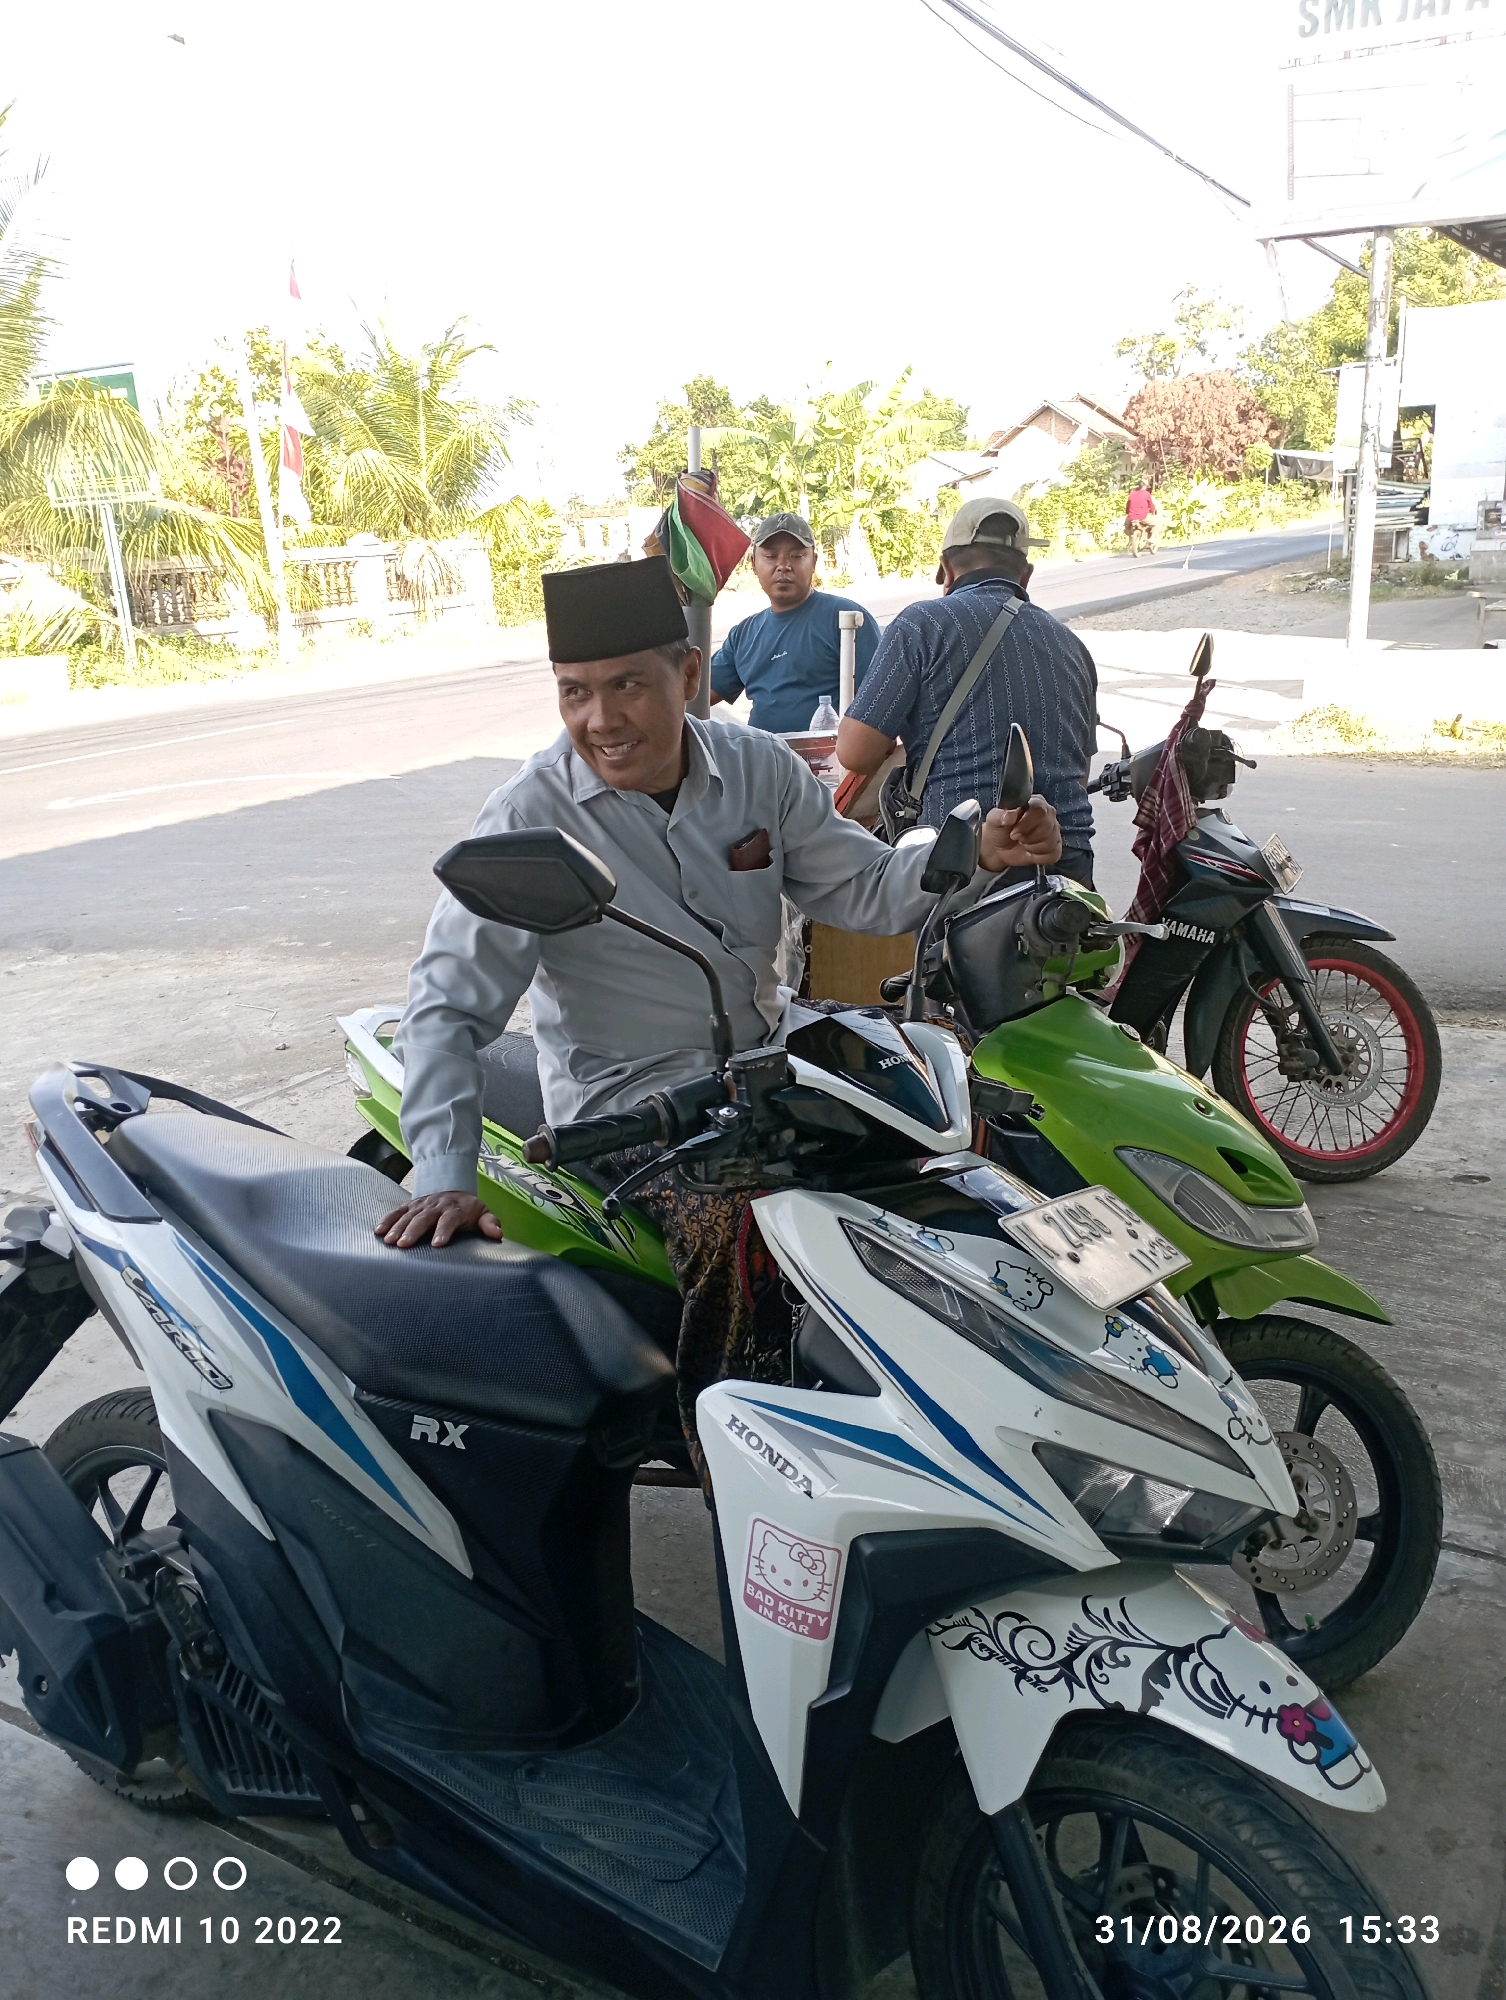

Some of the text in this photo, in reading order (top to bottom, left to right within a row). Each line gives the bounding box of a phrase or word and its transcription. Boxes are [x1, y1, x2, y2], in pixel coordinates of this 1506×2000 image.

[1162, 916, 1216, 944] YAMAHA
[121, 1266, 233, 1390] VARIO
[410, 1414, 470, 1450] RX
[725, 1414, 814, 1500] HONDA
[746, 1582, 829, 1627] BAD KITTY
[758, 1605, 810, 1635] IN CAR
[1008, 1665, 1049, 1693] Bake
